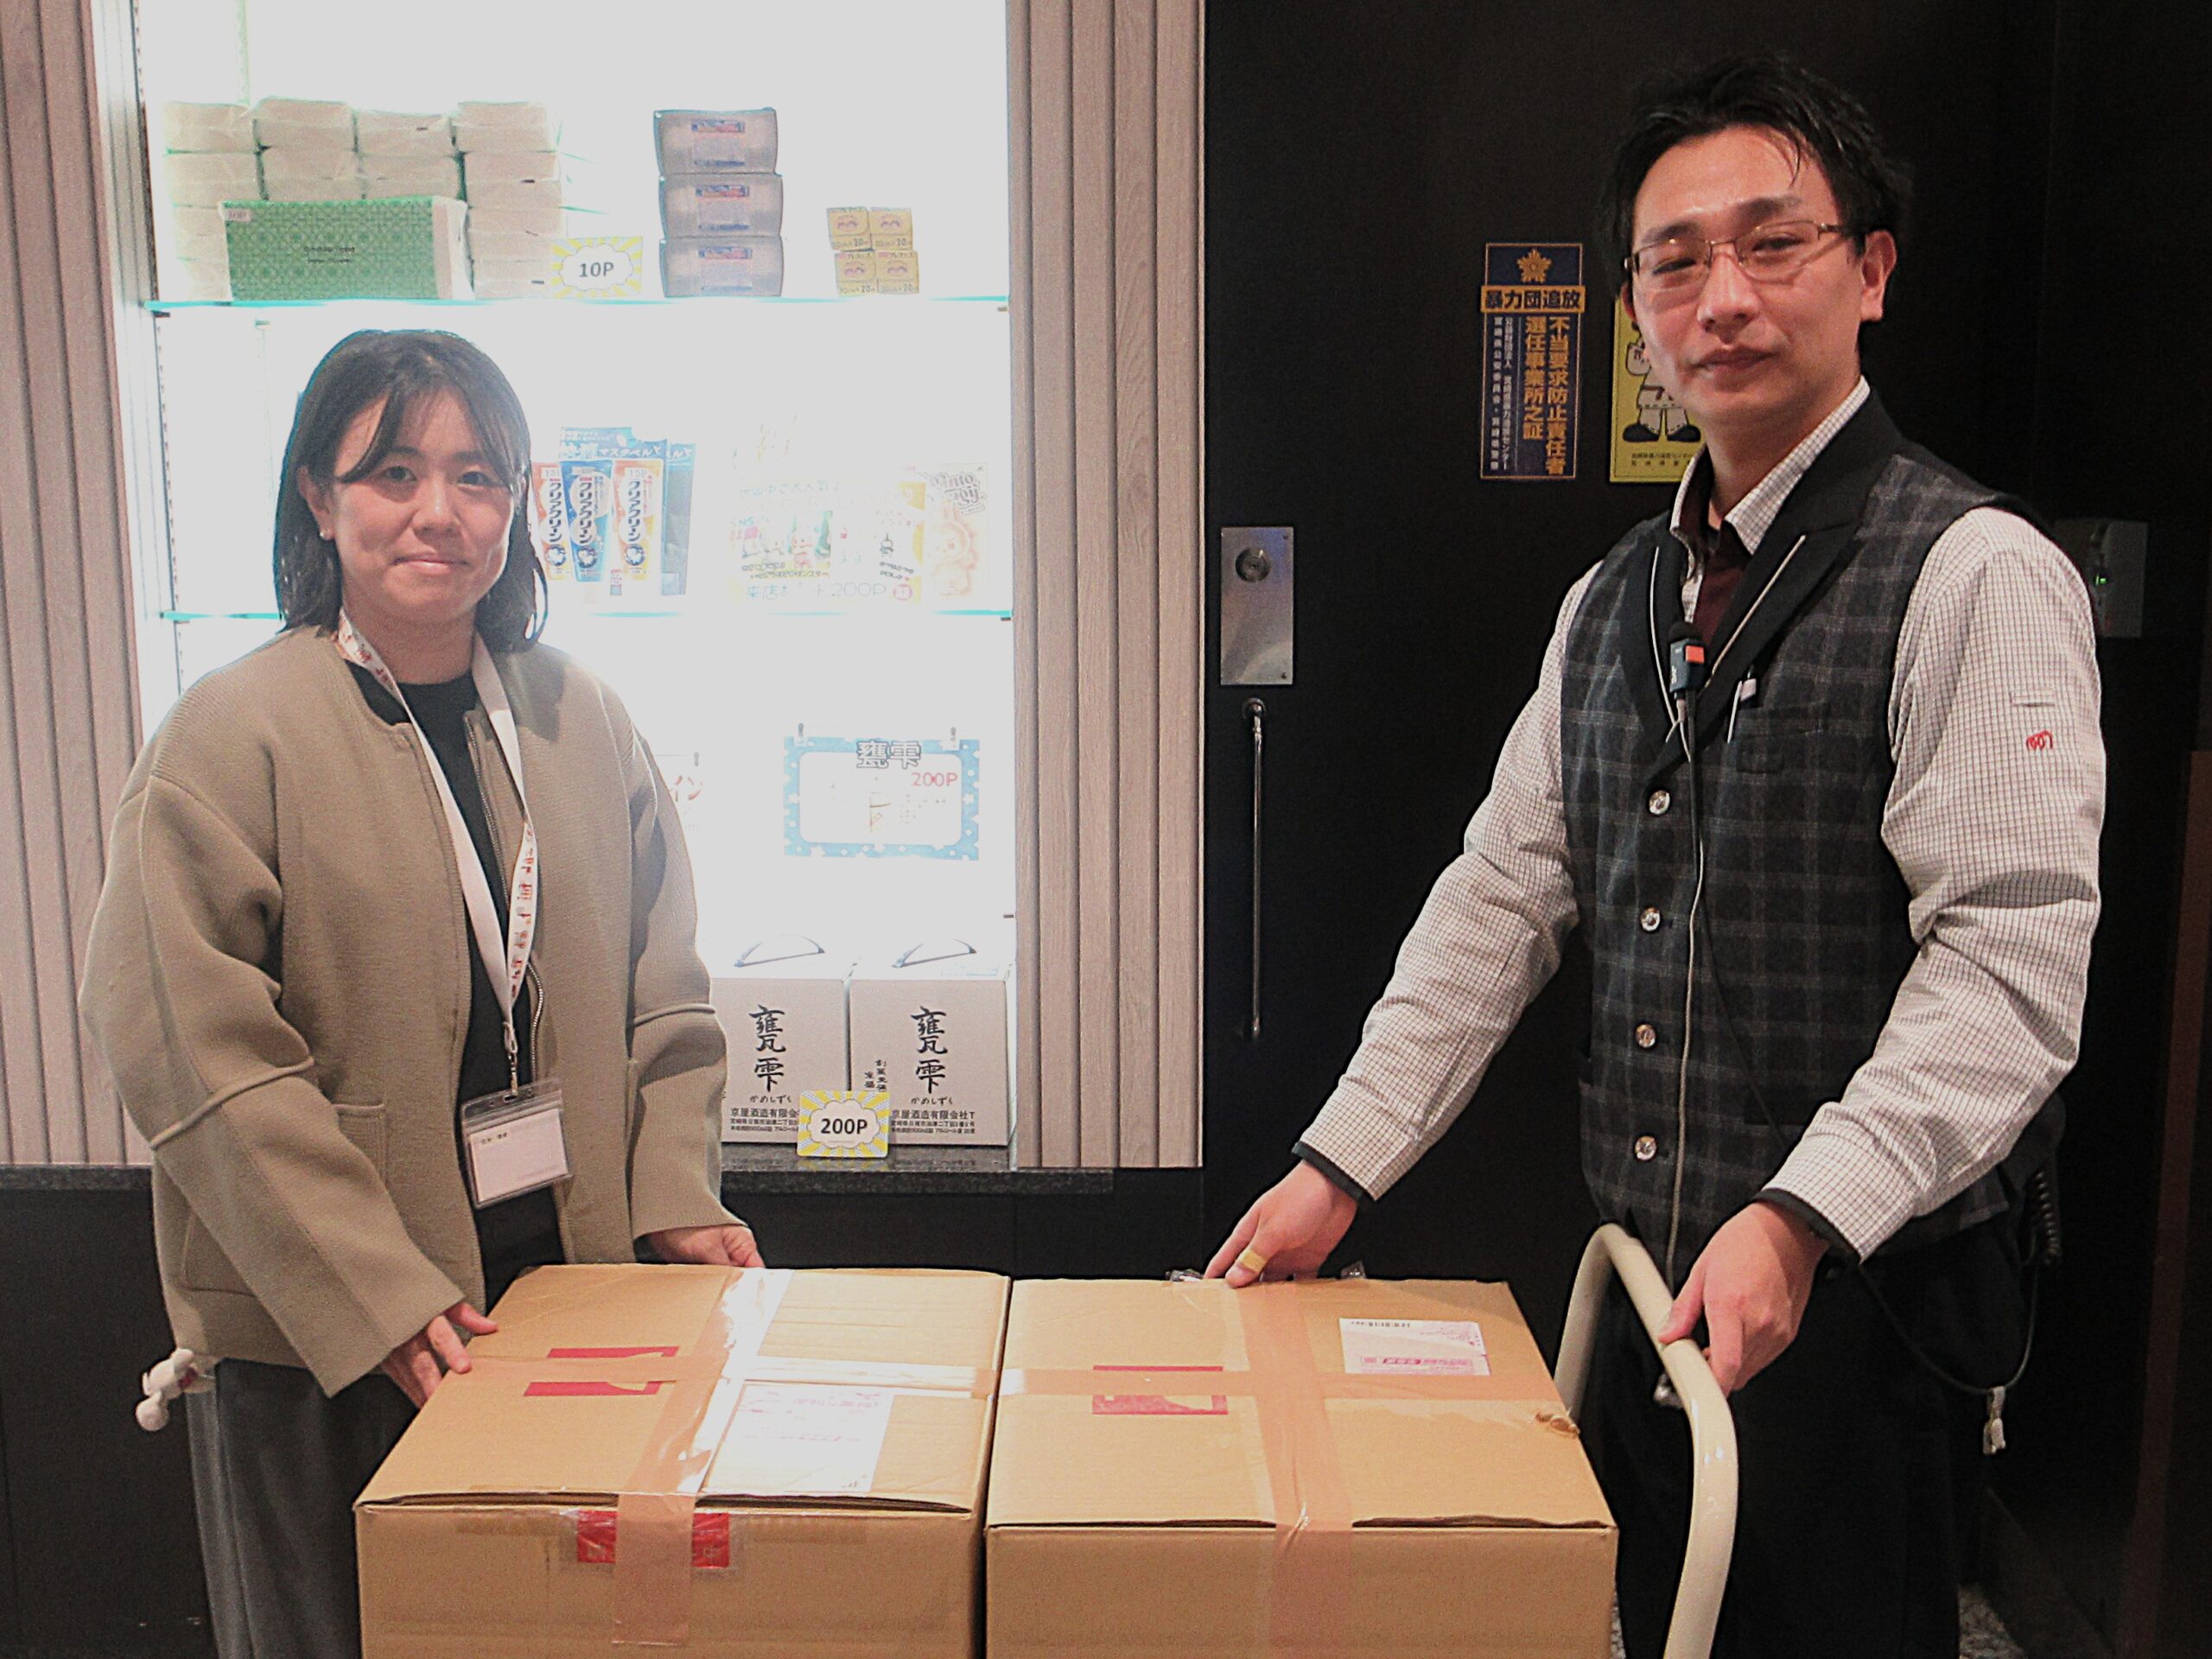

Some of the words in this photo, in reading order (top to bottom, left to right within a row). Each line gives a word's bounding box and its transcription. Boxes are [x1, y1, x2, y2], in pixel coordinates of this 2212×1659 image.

[578, 261, 615, 279] 10P
[1484, 289, 1581, 309] 暴力団追放
[1522, 315, 1547, 440] 選任事業所之証
[1546, 315, 1570, 475] 不当要求防止責任者
[548, 482, 563, 543] クリアクリーン
[579, 481, 593, 544] クリアクリーン
[627, 480, 641, 543] クリアクリーン
[830, 582, 887, 598] 200P
[856, 739, 922, 770] 甕雫
[912, 772, 958, 787] 200P
[748, 1004, 786, 1093] 甕雫
[910, 1005, 948, 1095] 甕雫
[749, 1095, 792, 1104] かめしずく
[911, 1096, 953, 1106] かめしずく
[730, 1108, 799, 1118] 京屋酒造有限会
[820, 1117, 868, 1135] 200P
